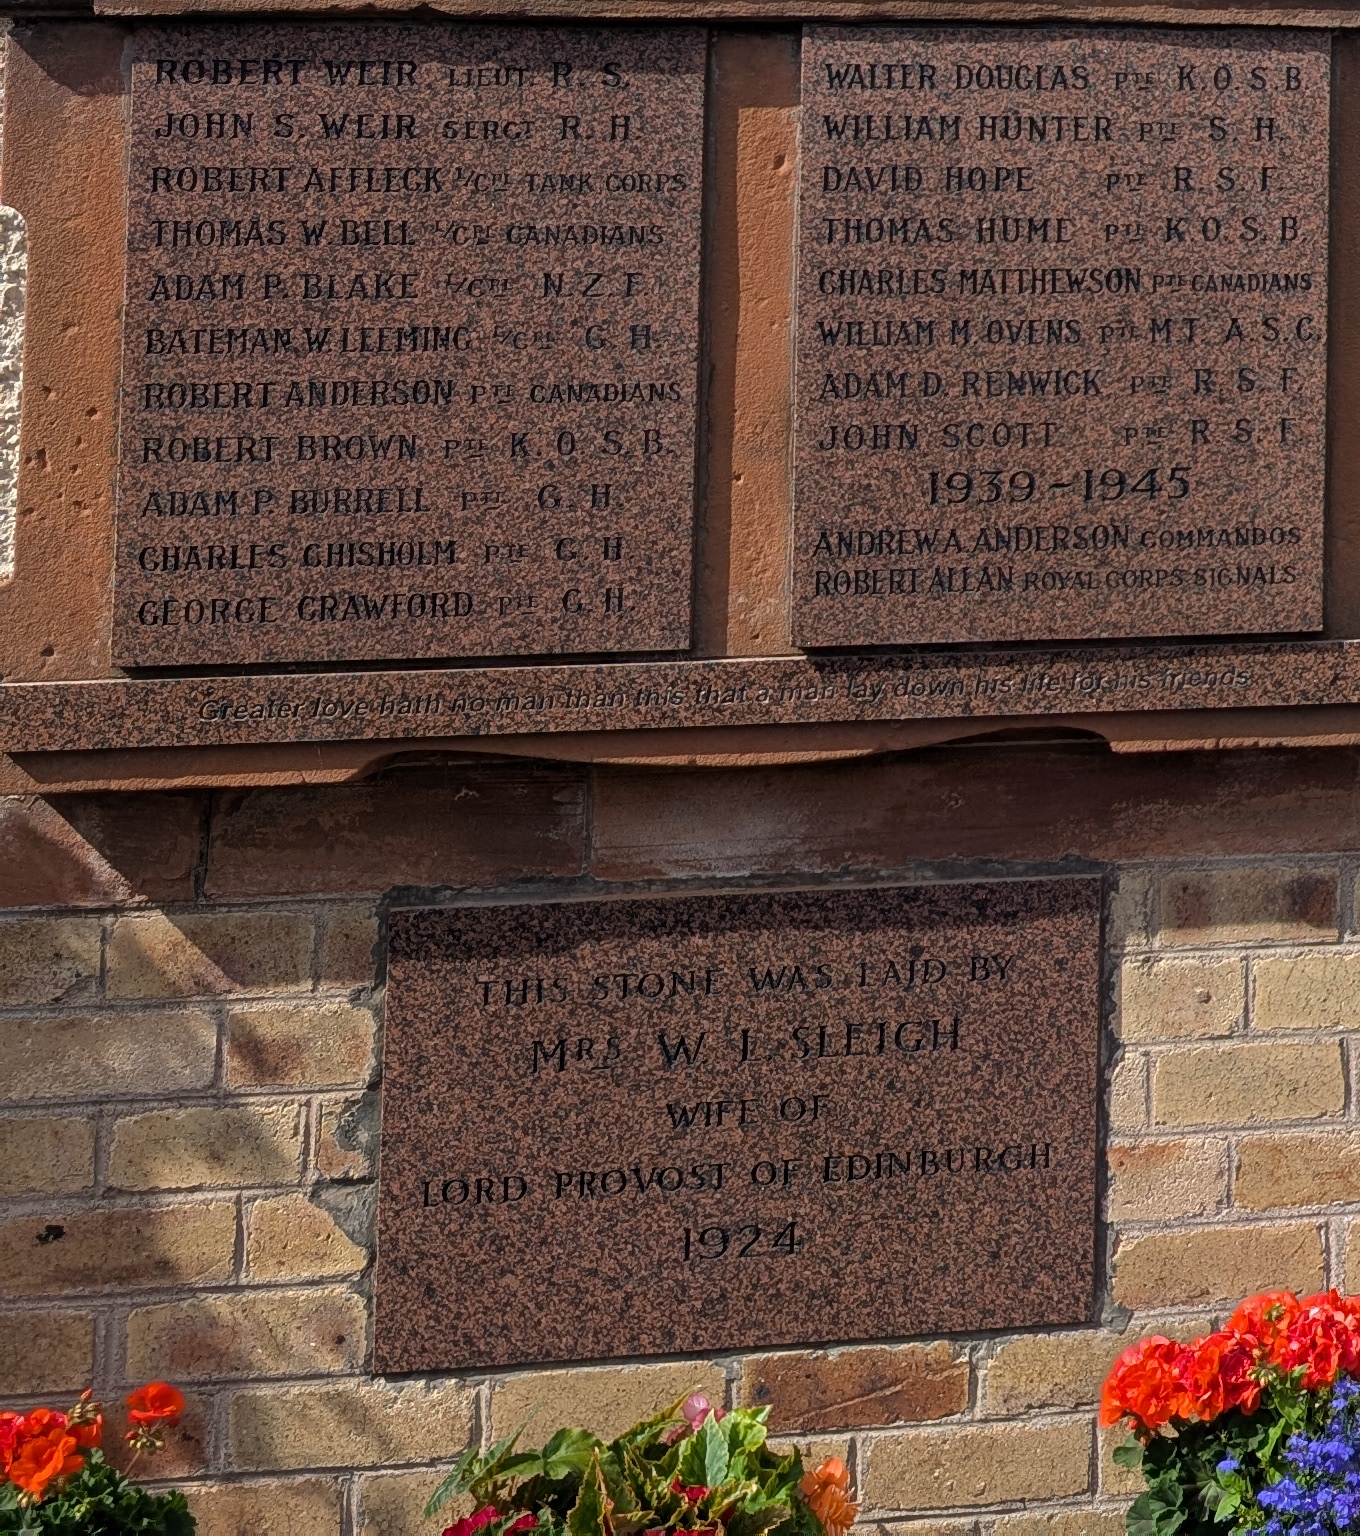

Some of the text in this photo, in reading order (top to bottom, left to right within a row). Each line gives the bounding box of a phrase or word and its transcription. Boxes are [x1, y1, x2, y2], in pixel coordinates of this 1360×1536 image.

[156, 59, 305, 86] ROBERT
[323, 60, 418, 86] WEIR
[825, 64, 937, 90] WALTER
[956, 64, 1089, 91] DOUGLAS
[155, 113, 254, 139] JOHN
[320, 114, 417, 140] WEIR
[824, 115, 961, 141] WILLIAM
[978, 115, 1113, 142] HUNTER
[151, 166, 688, 193] ROBERT AFFLECK TANK CORPS
[822, 166, 923, 192] DAVID
[946, 166, 1034, 192] HOPE
[152, 220, 287, 247] THOMAS
[340, 220, 416, 245] BELL
[506, 224, 664, 245] CANADIANS
[823, 218, 954, 245] THOMAS
[976, 217, 1075, 244] HUME
[150, 273, 419, 301] ADAM P. BLAKE
[818, 267, 1313, 296] CHARLES MATTHEWSON CANADIANS
[146, 328, 293, 354] BATEMAN
[341, 326, 471, 353] LEEMING
[818, 320, 935, 347] WILLIAM
[986, 319, 1082, 346] OVENS
[144, 383, 275, 410] ROBERT
[285, 380, 453, 407] ANDERSON
[530, 382, 682, 404] CANADIANS
[819, 372, 908, 401] ADAM
[961, 370, 1103, 398] RENWICK
[142, 436, 280, 464] ROBERT
[298, 435, 418, 462] BROWN
[818, 424, 919, 451] JOHN
[942, 422, 1057, 449] SCOTT
[142, 490, 239, 517] ADAM
[291, 487, 431, 515] BURRELL
[138, 544, 287, 572] CHARLES
[303, 540, 457, 568] CHISHOLM
[811, 529, 940, 558] ANDREW
[972, 525, 1130, 553] ANDERSON
[1140, 527, 1301, 548] COMMANDOS
[815, 566, 1297, 597] ROBERT ALLAN ROYAL CORPS SIGNALS
[137, 596, 278, 627] GEORGE
[298, 591, 474, 622] CRAWFORD
[199, 667, 1252, 722] Greater love hath no man than this that a man lay down his life for his friends
[475, 955, 1015, 1007] THIS STONE WAS LAID BY
[792, 1017, 961, 1061] SLEIGH
[667, 1094, 830, 1129] WIFE OF
[423, 1143, 1051, 1208] LORD PROVOST OF EDINBURGH
[684, 1221, 800, 1262] 1924
